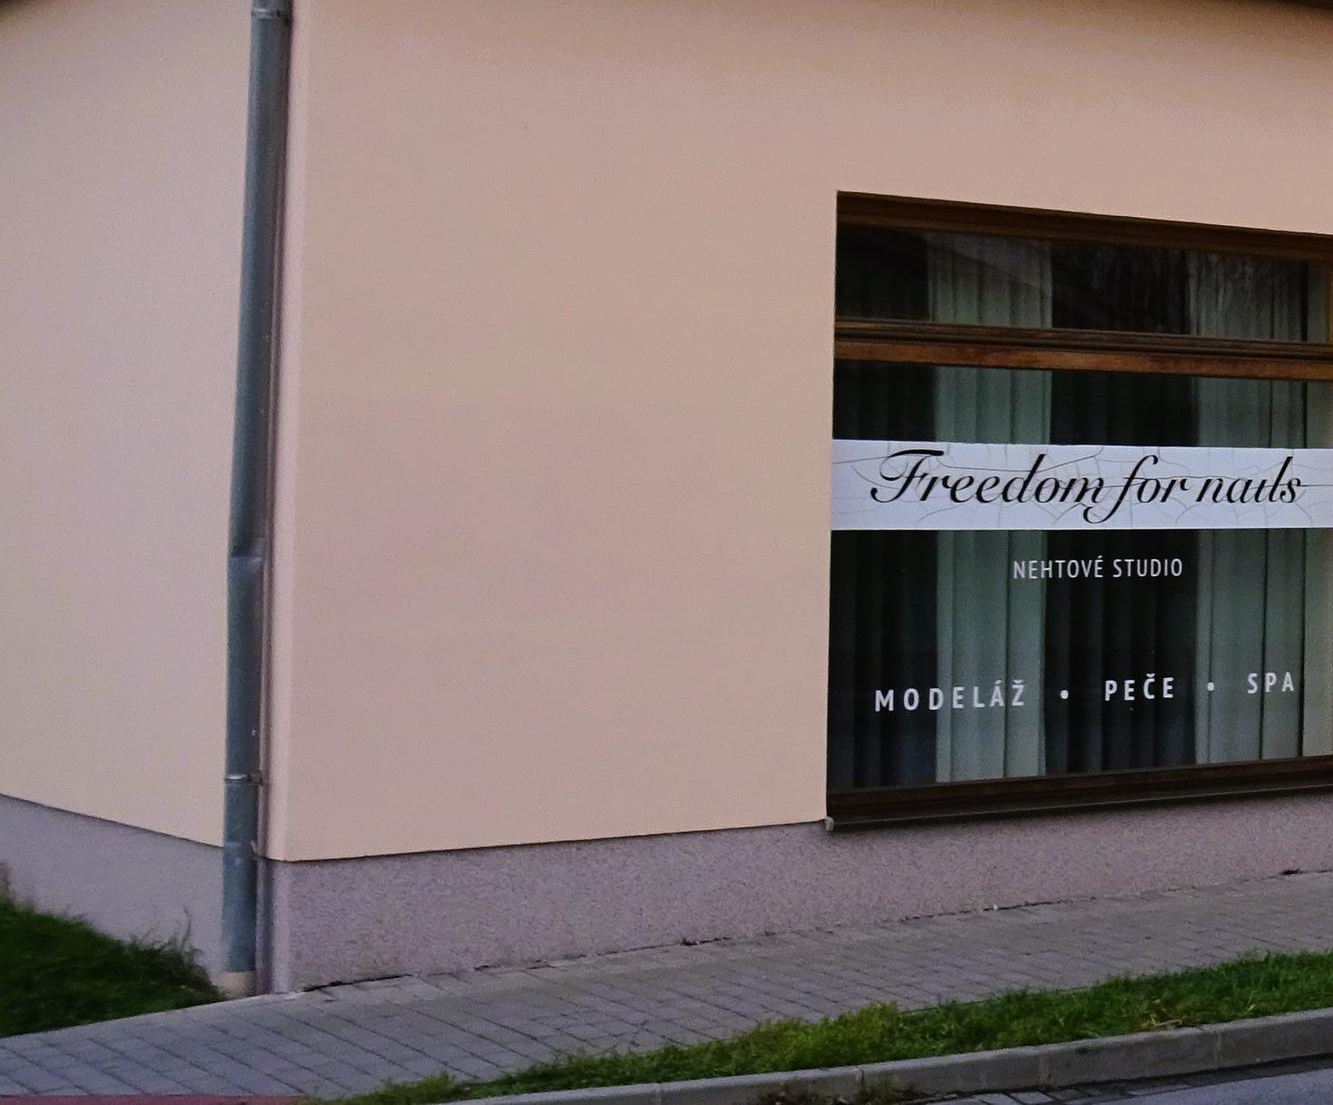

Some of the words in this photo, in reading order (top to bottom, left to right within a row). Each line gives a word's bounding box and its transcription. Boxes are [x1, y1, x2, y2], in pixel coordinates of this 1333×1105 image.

[869, 449, 1106, 506] Freedom
[1082, 454, 1194, 524] for
[1197, 455, 1304, 505] nails
[1012, 554, 1104, 581] NEHTOVÉ
[1112, 556, 1184, 578] STUDIO
[874, 677, 1026, 713] MODELÁŽ
[1104, 672, 1176, 702] PEČE
[1247, 671, 1296, 695] SPA
